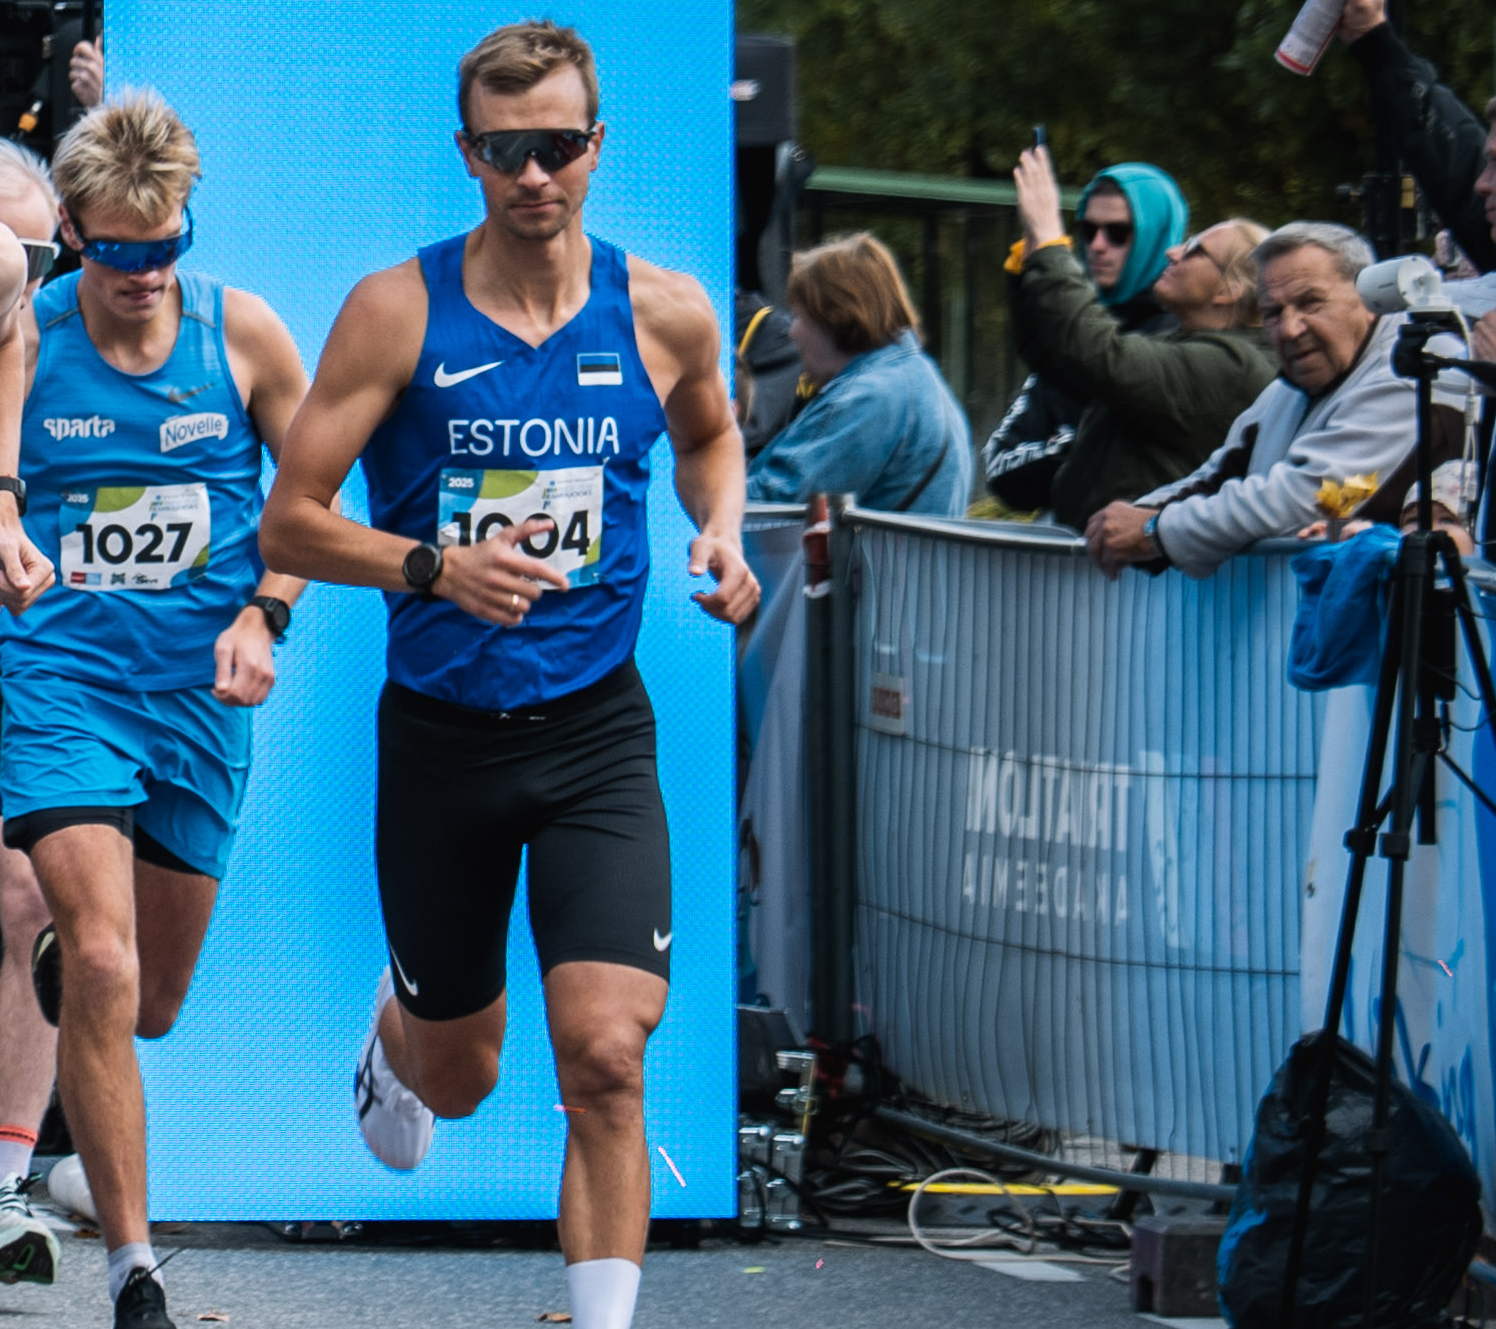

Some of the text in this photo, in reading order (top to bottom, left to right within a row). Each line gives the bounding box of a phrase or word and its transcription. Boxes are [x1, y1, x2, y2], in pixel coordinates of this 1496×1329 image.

[43, 415, 116, 442] sparta
[165, 417, 223, 448] Novelle
[448, 416, 620, 457] ESTONIA
[448, 477, 474, 489] 2025
[76, 522, 194, 565] 1027
